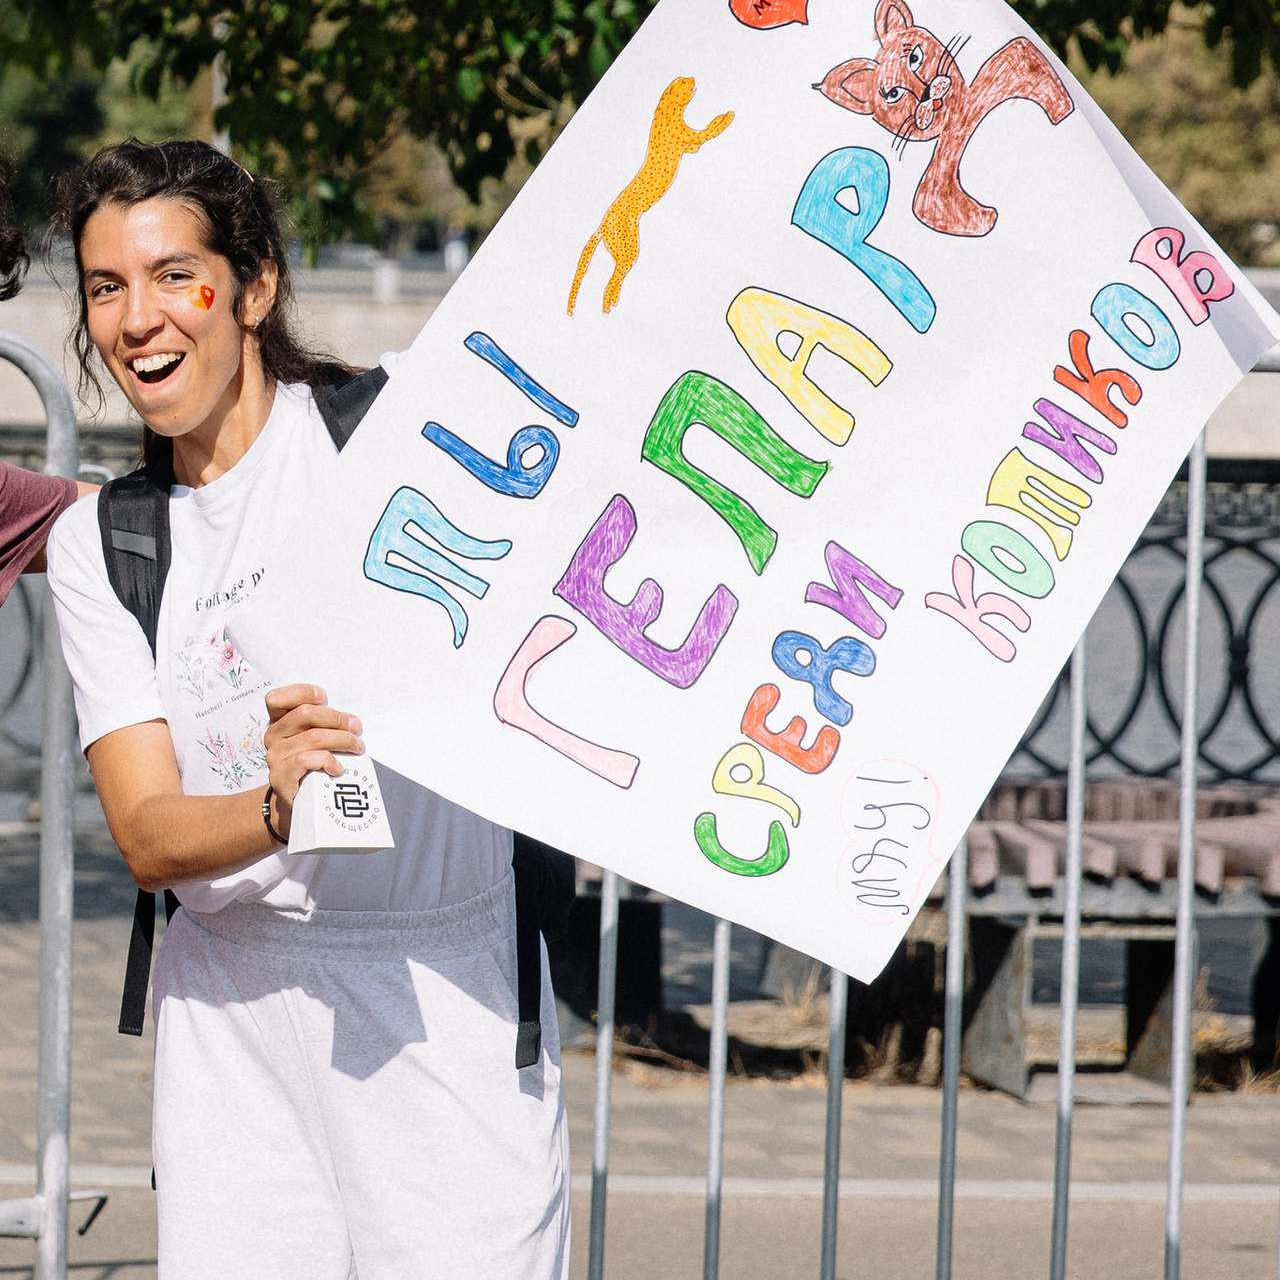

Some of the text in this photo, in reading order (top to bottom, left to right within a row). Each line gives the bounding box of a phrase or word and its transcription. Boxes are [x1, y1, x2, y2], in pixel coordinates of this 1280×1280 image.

[363, 330, 580, 648] ТЫ
[924, 226, 1235, 663] КОТИКОВ
[323, 768, 375, 790] БЕОВОЕ
[325, 805, 380, 833] СООБЩЕСТВО
[694, 539, 905, 877] СРЕДИ
